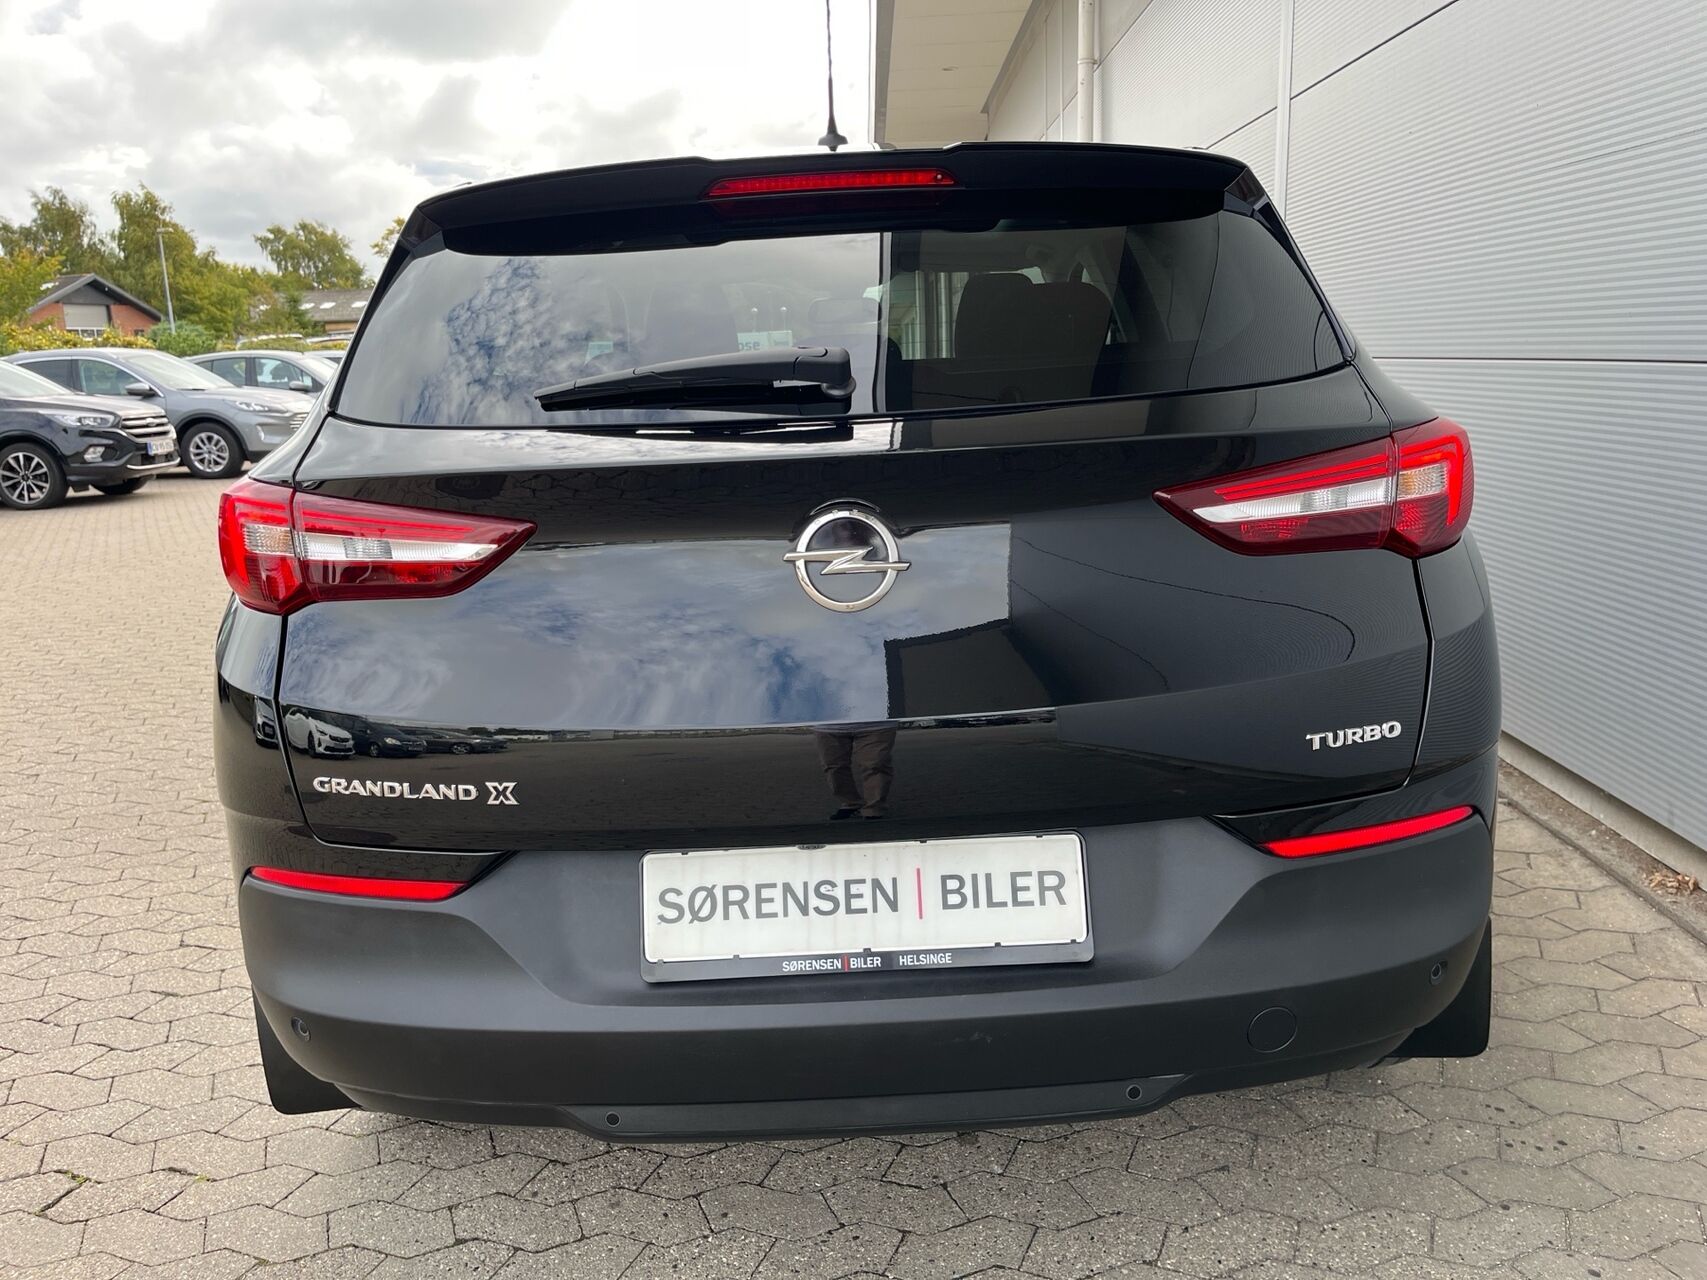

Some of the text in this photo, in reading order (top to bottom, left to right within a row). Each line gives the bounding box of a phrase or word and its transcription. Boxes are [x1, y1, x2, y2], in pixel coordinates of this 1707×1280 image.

[1305, 720, 1402, 751] TURBO
[312, 776, 520, 805] GRANDLAND X
[656, 869, 1068, 925] SØRENSEN BILER
[782, 952, 953, 972] SØRENSEN BILER HELSINGE
